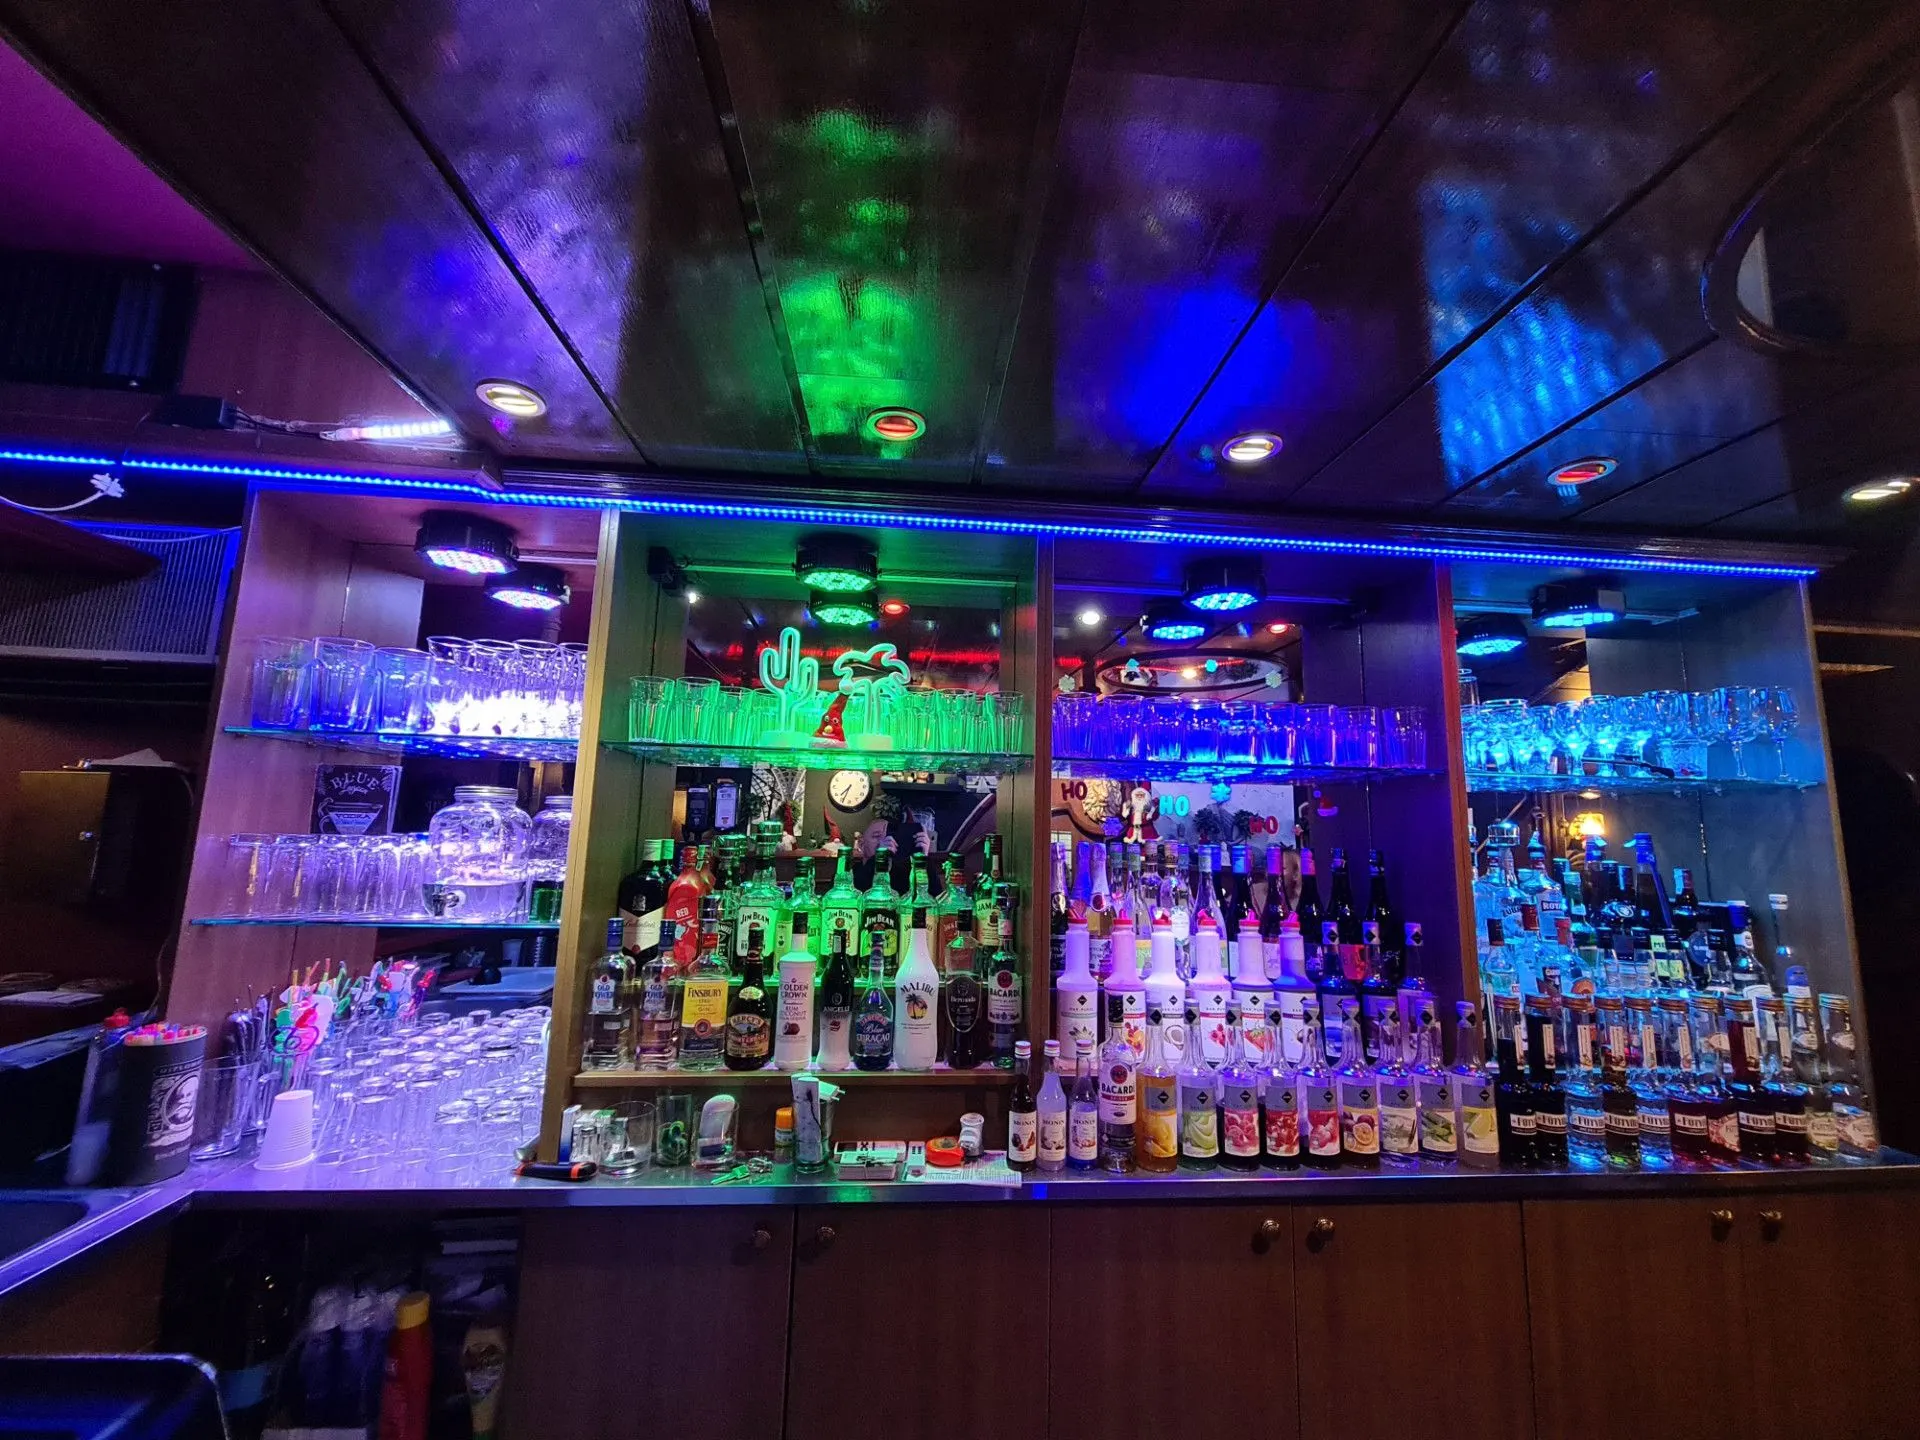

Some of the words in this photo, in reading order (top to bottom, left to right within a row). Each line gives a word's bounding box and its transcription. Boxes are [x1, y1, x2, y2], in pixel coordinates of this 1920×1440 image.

[1061, 781, 1088, 801] HO
[1159, 795, 1190, 817] HO
[1250, 815, 1279, 834] HO
[741, 914, 753, 925] JIM
[753, 912, 770, 925] BEAM
[838, 910, 853, 919] BEAM
[865, 916, 877, 928] JIM
[877, 914, 895, 927] BEAM
[688, 987, 722, 998] FINSBURY
[900, 982, 935, 997] MALIBU
